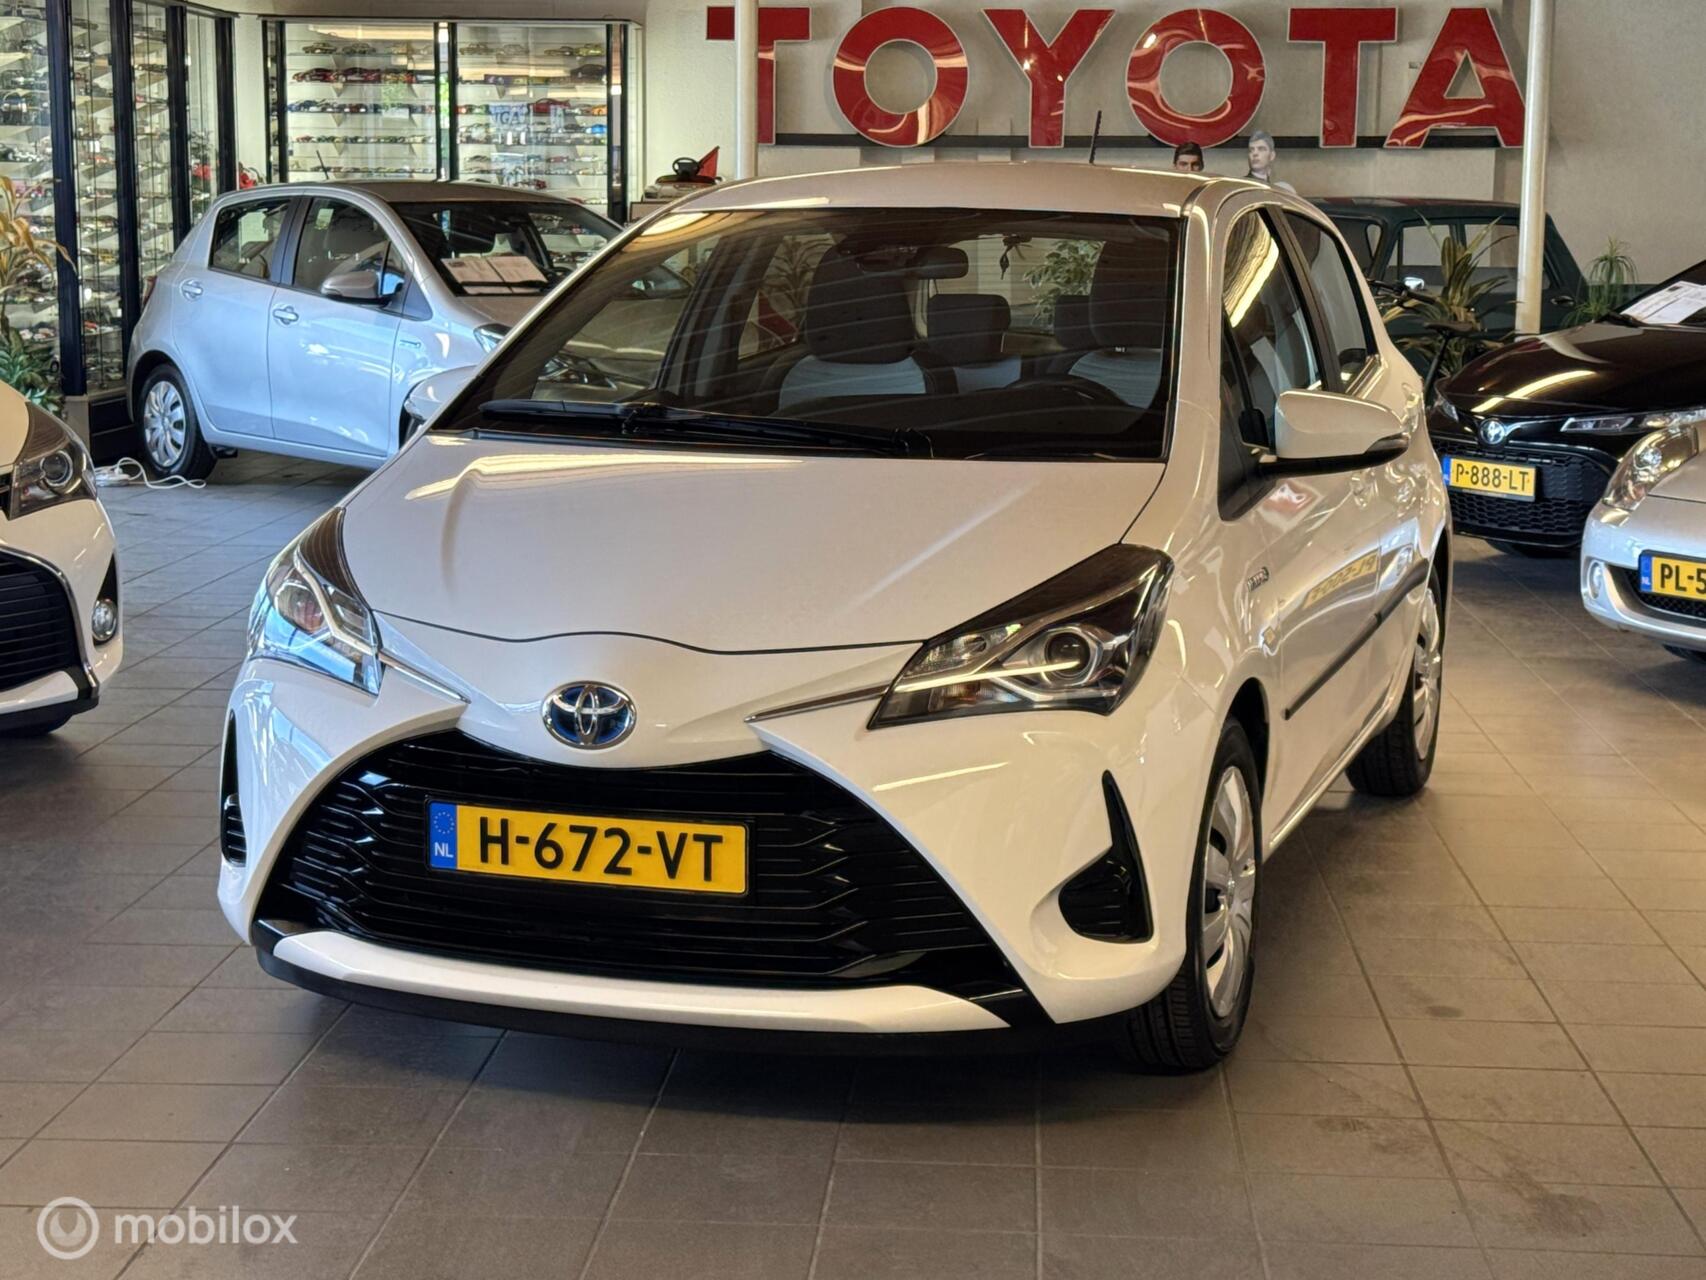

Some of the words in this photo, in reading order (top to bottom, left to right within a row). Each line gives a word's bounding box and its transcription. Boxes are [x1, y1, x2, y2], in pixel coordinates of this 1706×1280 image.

[706, 6, 1525, 149] TOYOTA
[1455, 462, 1529, 492] P-888-LT
[1660, 562, 1706, 595] PL-5
[433, 841, 454, 858] NL
[479, 816, 724, 882] H-672-VT
